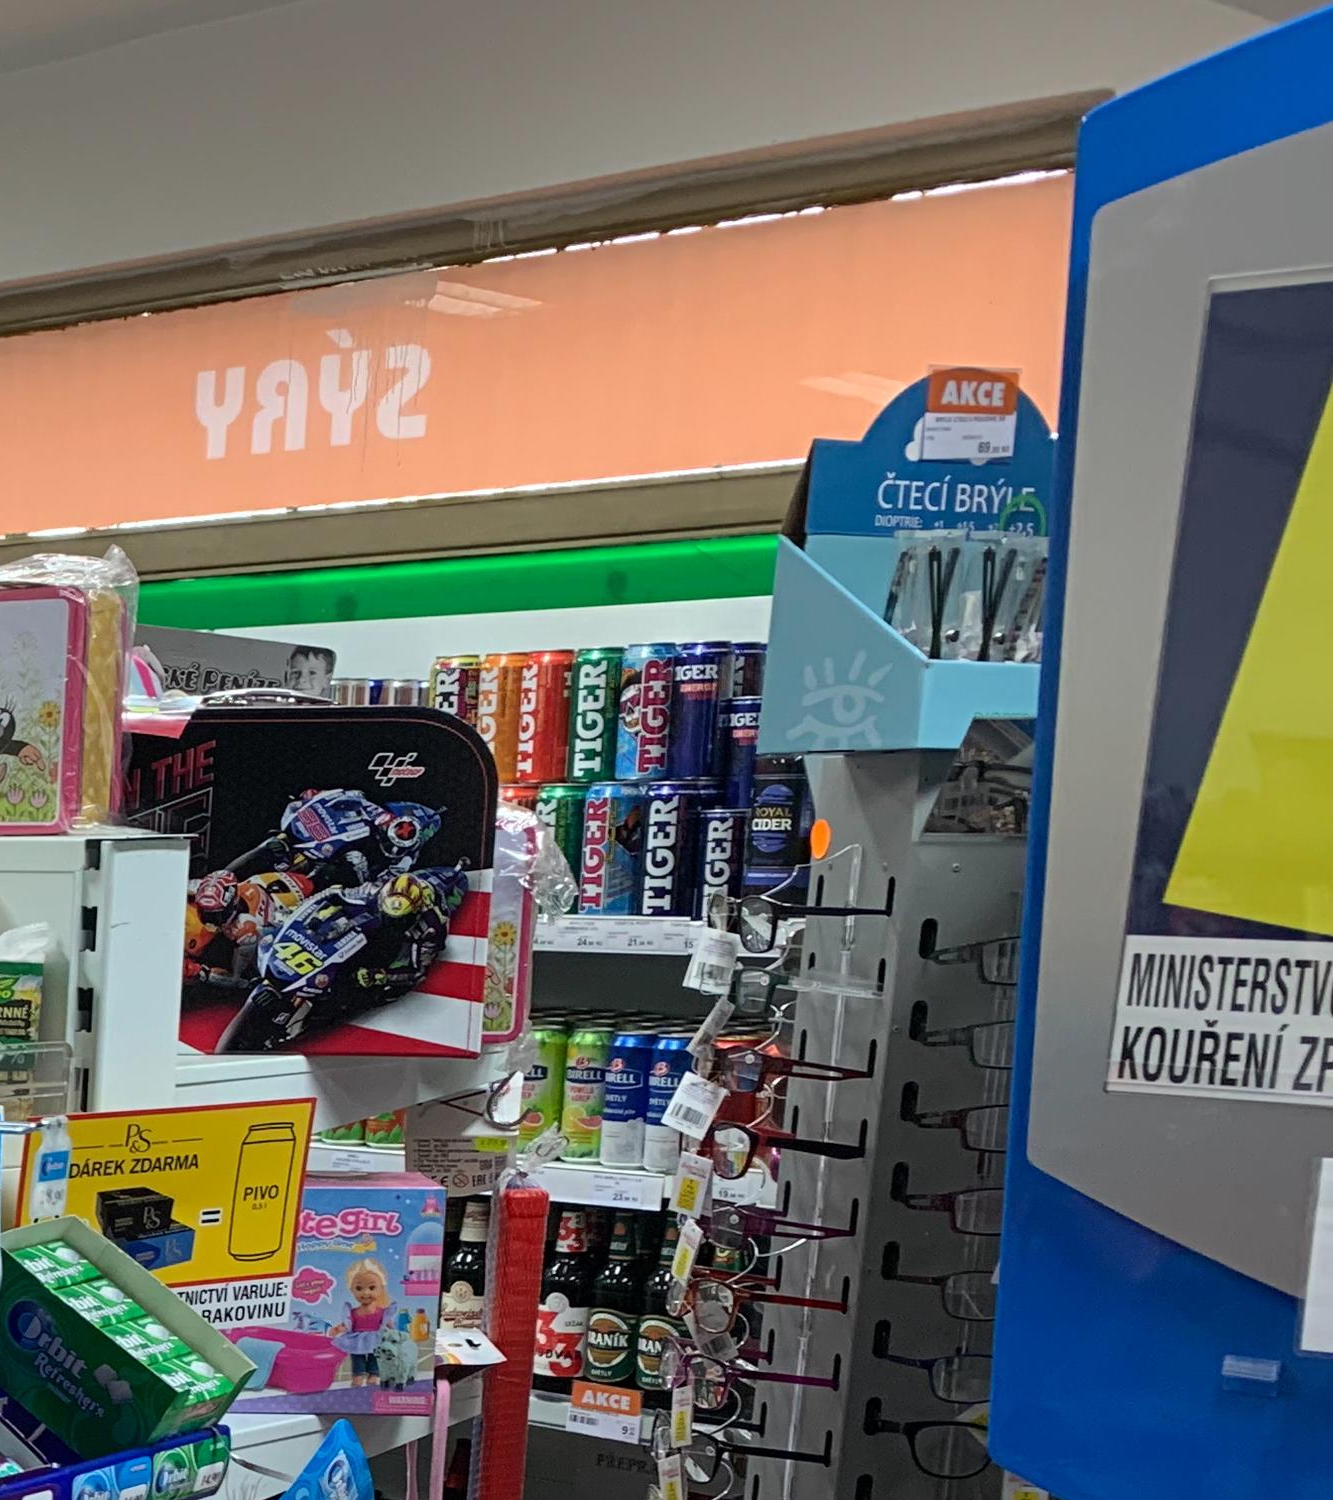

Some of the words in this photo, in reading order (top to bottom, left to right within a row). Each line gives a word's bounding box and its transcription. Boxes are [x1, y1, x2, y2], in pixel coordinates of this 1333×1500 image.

[941, 380, 1007, 408] AKCE
[877, 471, 952, 512] ČTECÍ
[515, 662, 540, 776] TIGER
[571, 658, 610, 779] TIGER
[636, 656, 677, 775] TIGER
[151, 739, 217, 801] THE
[751, 818, 793, 832] CIDER
[579, 796, 610, 914] TIGER
[641, 795, 680, 916] TIGER
[272, 941, 324, 976] 46
[283, 927, 328, 961] movistar
[1118, 1017, 1291, 1088] KOUŘENÍ
[566, 1068, 604, 1081] BIRELL
[67, 1154, 125, 1180] DÁREK
[129, 1154, 200, 1175] ZDARMA
[242, 1184, 280, 1202] PIVO
[232, 1281, 289, 1301] VARUJE:
[19, 1300, 90, 1382] Orbit
[582, 1388, 631, 1410] AKCE
